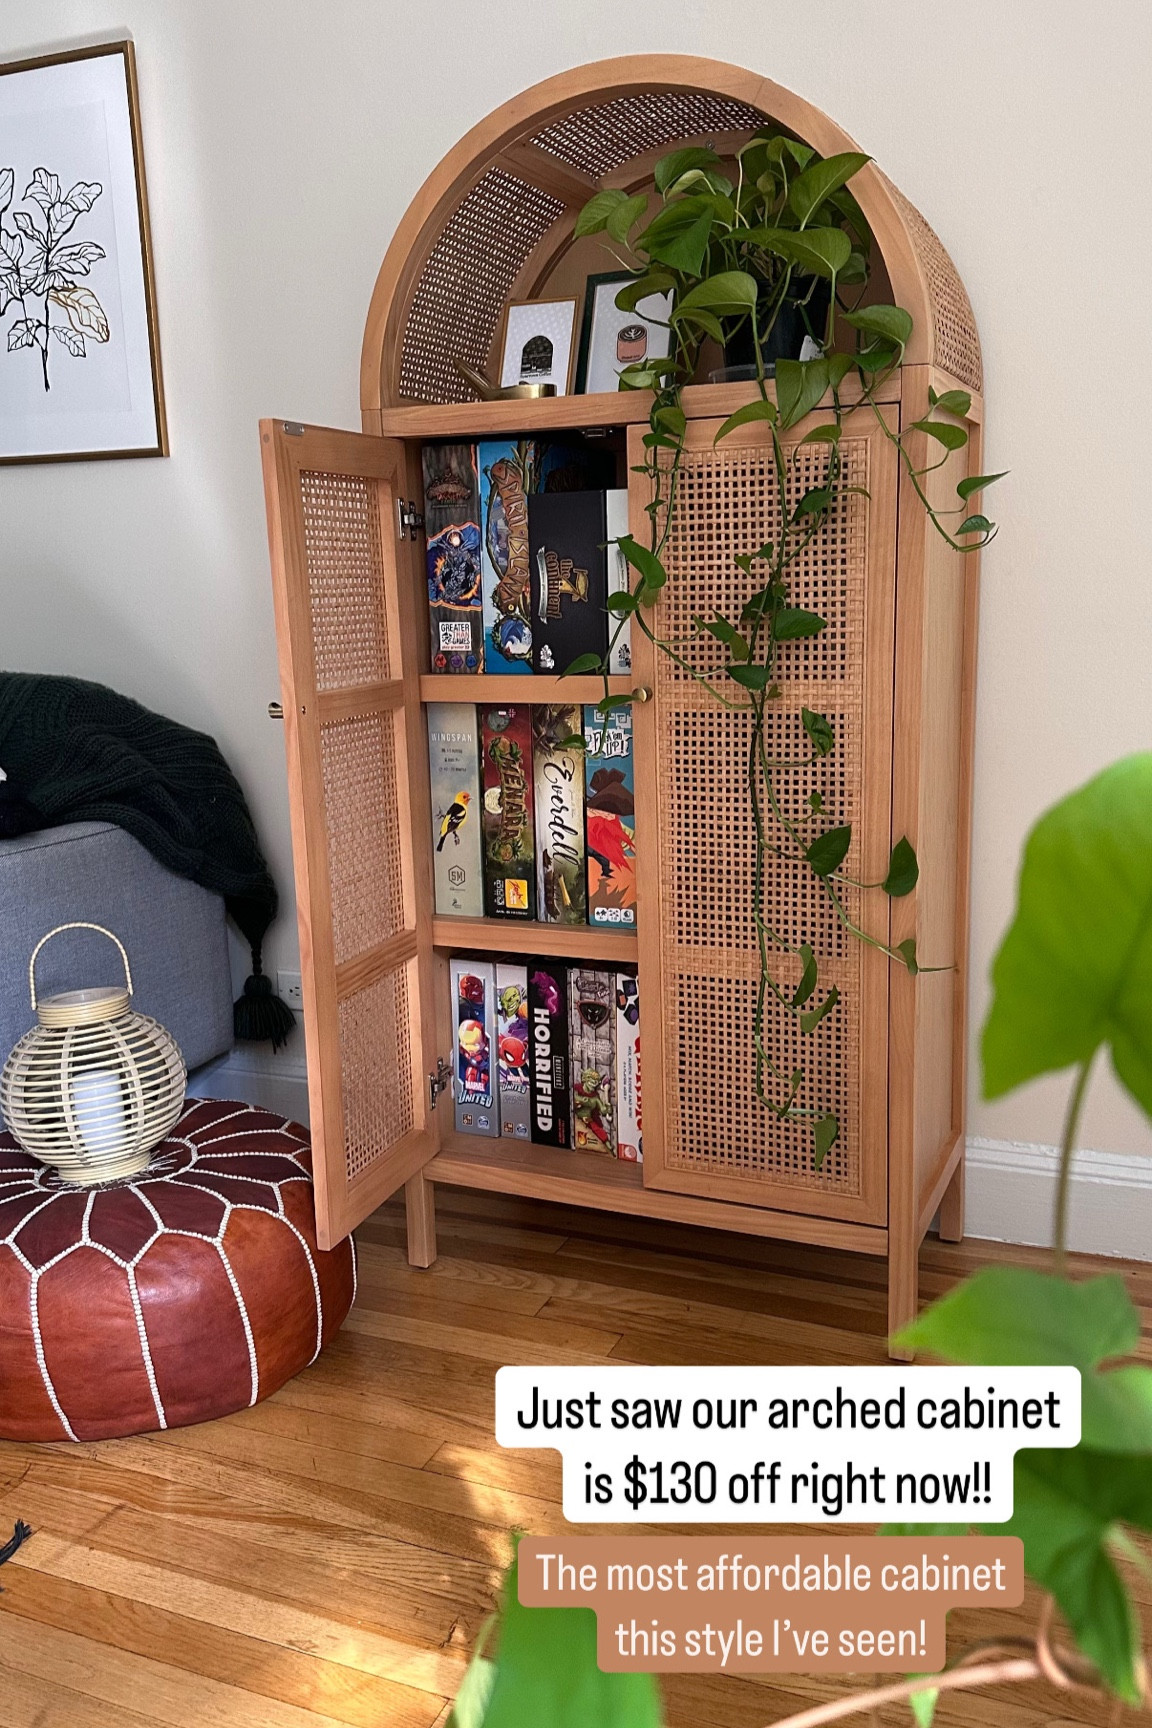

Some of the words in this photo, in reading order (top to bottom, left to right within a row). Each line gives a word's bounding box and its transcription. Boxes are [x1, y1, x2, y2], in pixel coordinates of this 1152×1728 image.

[493, 467, 528, 526] SPIRIT
[560, 559, 574, 579] the
[544, 551, 563, 619] continent
[441, 623, 470, 632] GREATER
[431, 732, 472, 743] WINGSPAN
[606, 740, 624, 756] UP!
[501, 755, 526, 842] MENARA
[543, 757, 579, 866] Everdell
[451, 871, 463, 882] SM
[533, 1007, 553, 1132] HORRIFIED
[465, 1080, 486, 1092] MARVEL
[502, 1081, 527, 1094] UNITED
[458, 1090, 493, 1109] UNITED
